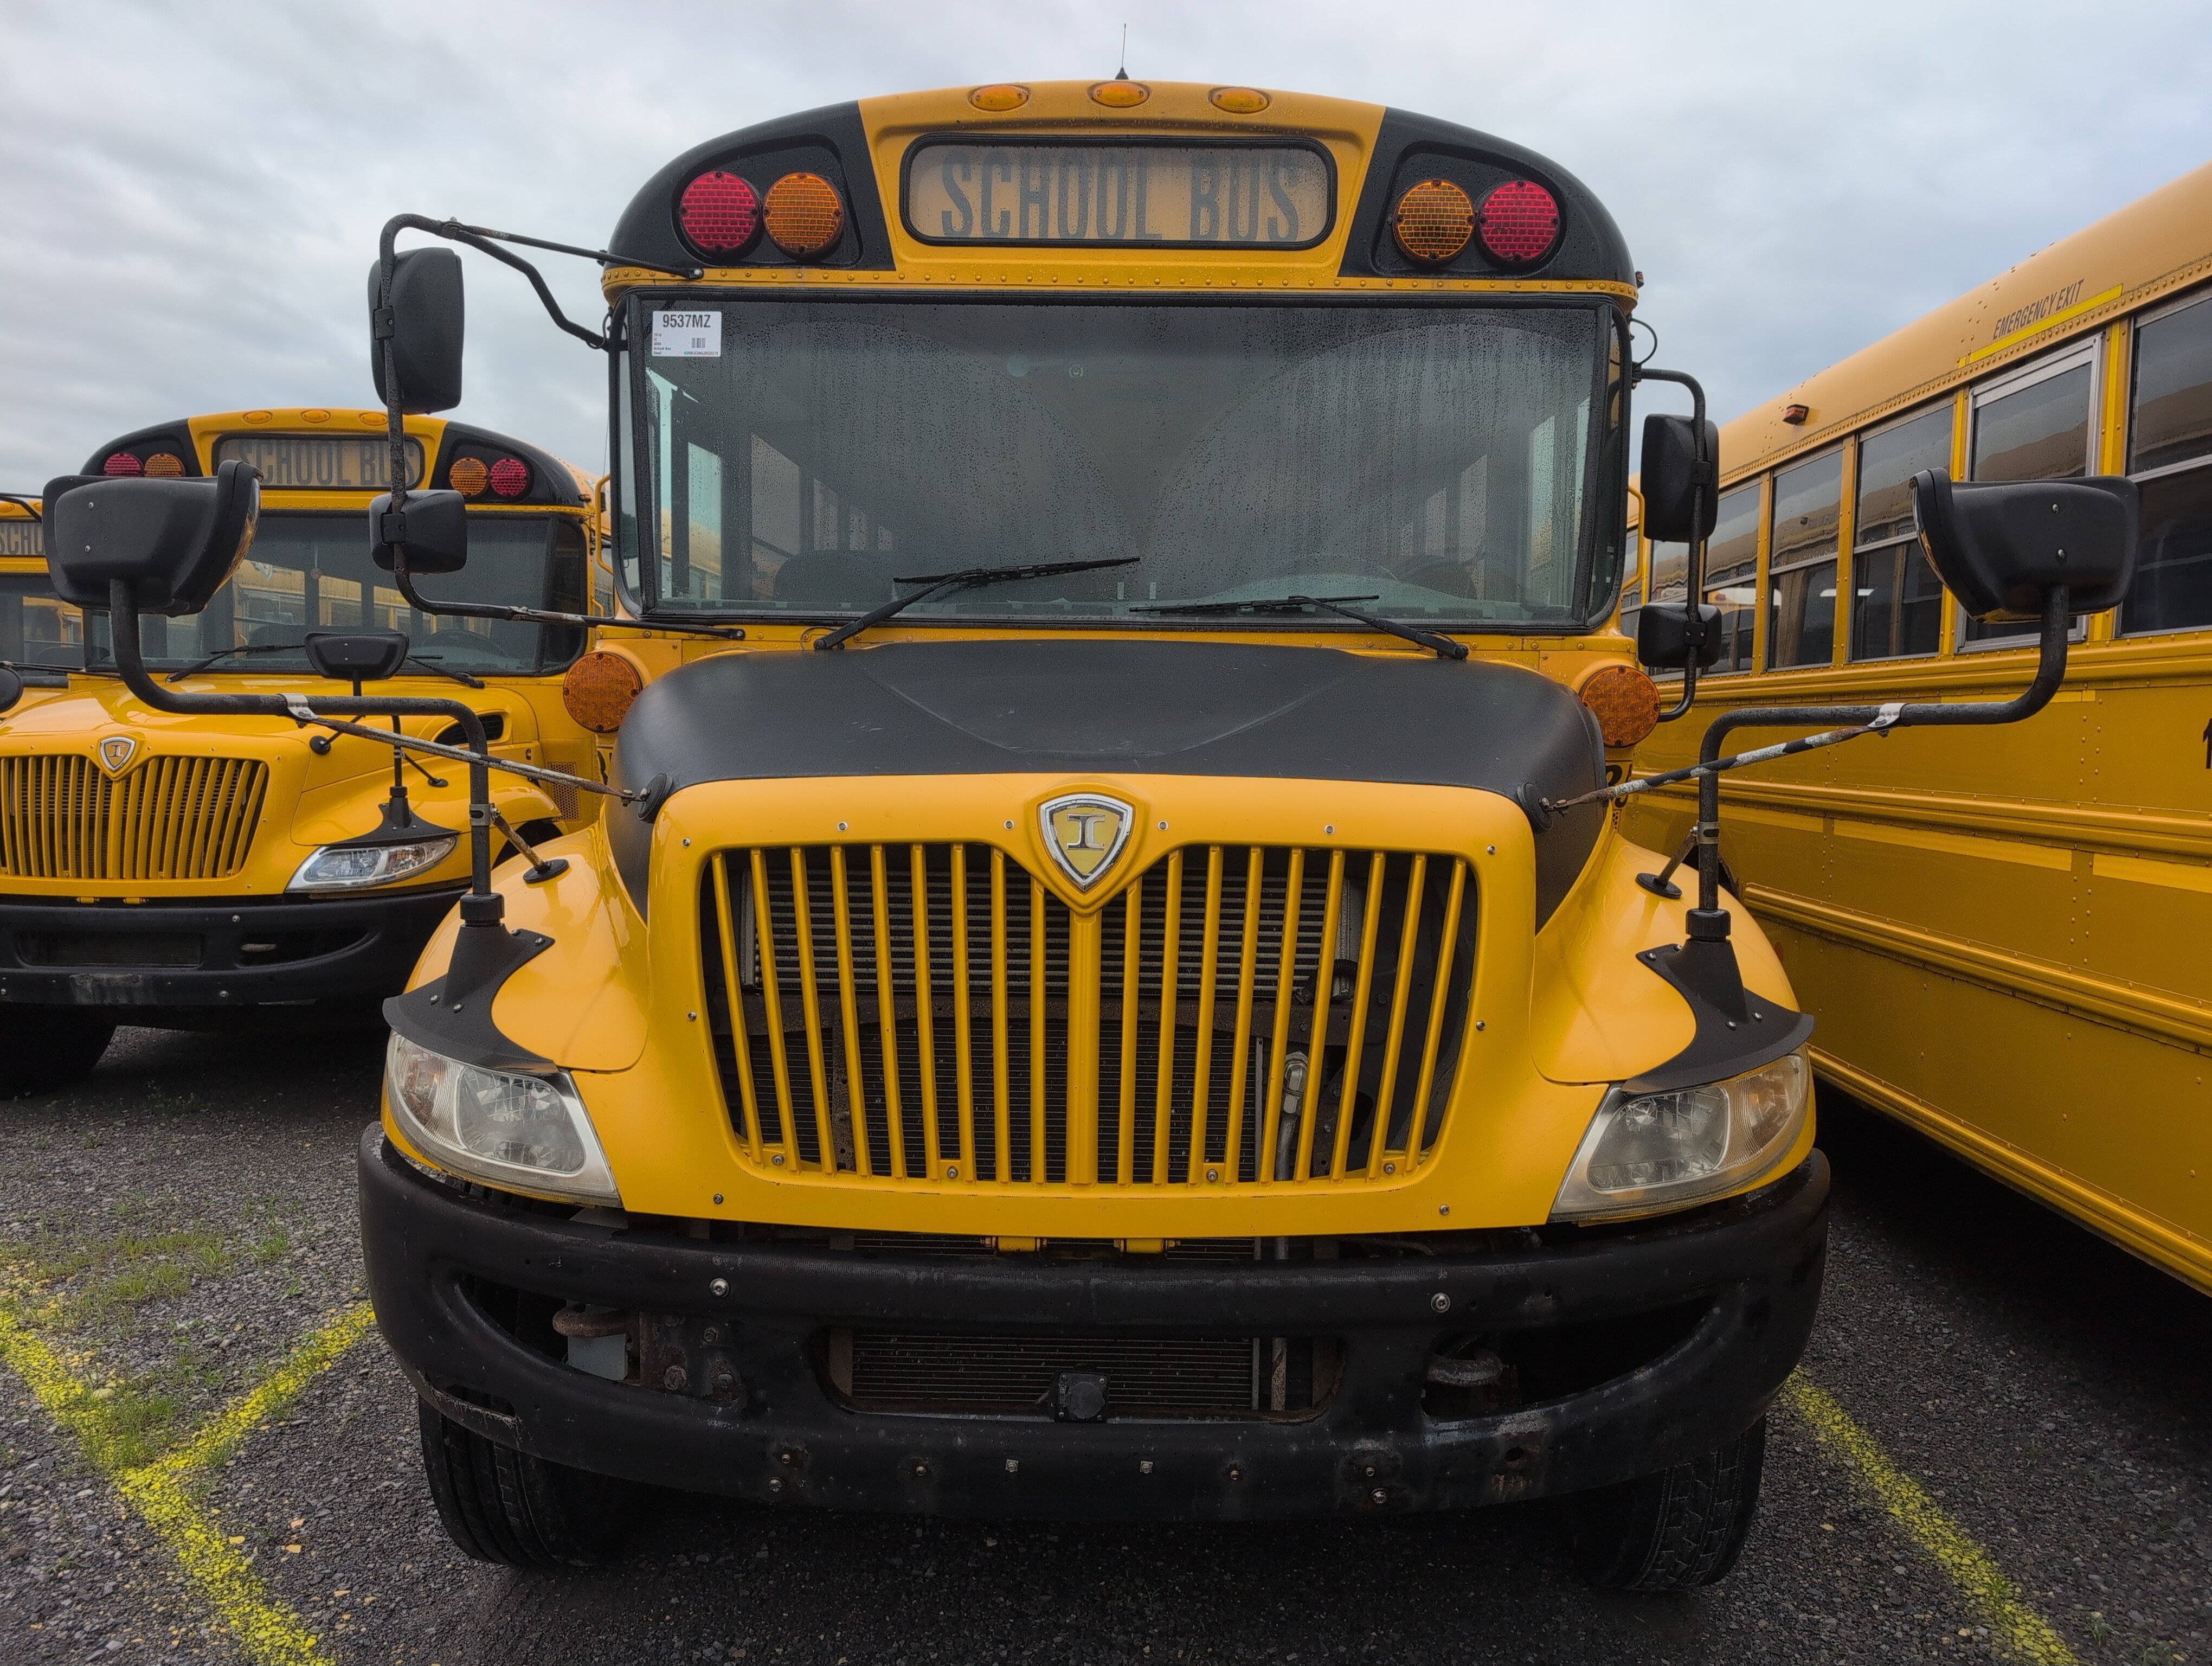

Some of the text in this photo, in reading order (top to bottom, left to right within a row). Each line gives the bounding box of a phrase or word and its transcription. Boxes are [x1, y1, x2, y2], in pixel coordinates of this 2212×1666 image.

[942, 151, 1299, 242] SCHOOL BUS
[663, 314, 711, 328] 9537MZ
[1992, 278, 2085, 341] EMERGENCY EXIT
